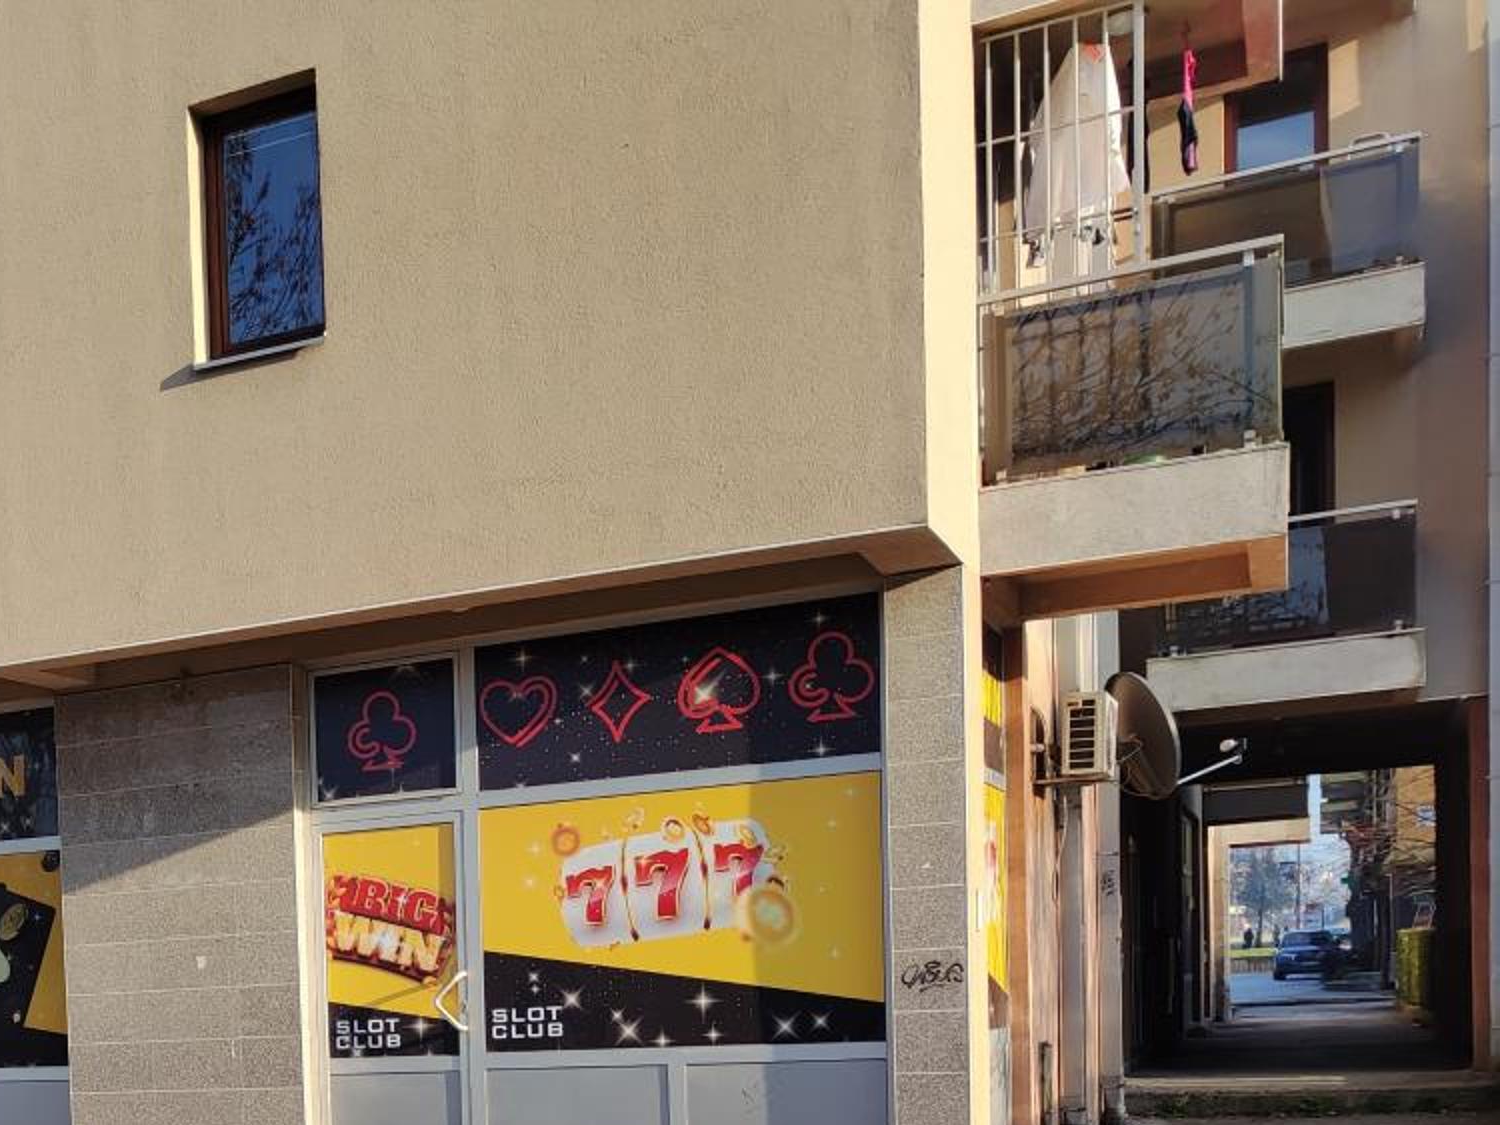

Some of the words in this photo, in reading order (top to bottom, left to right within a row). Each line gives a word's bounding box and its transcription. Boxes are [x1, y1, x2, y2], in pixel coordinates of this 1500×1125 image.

[492, 1005, 563, 1023] SLOT
[336, 1018, 400, 1034] SLOT
[492, 1022, 563, 1039] CLUB
[336, 1034, 401, 1049] CLUB
